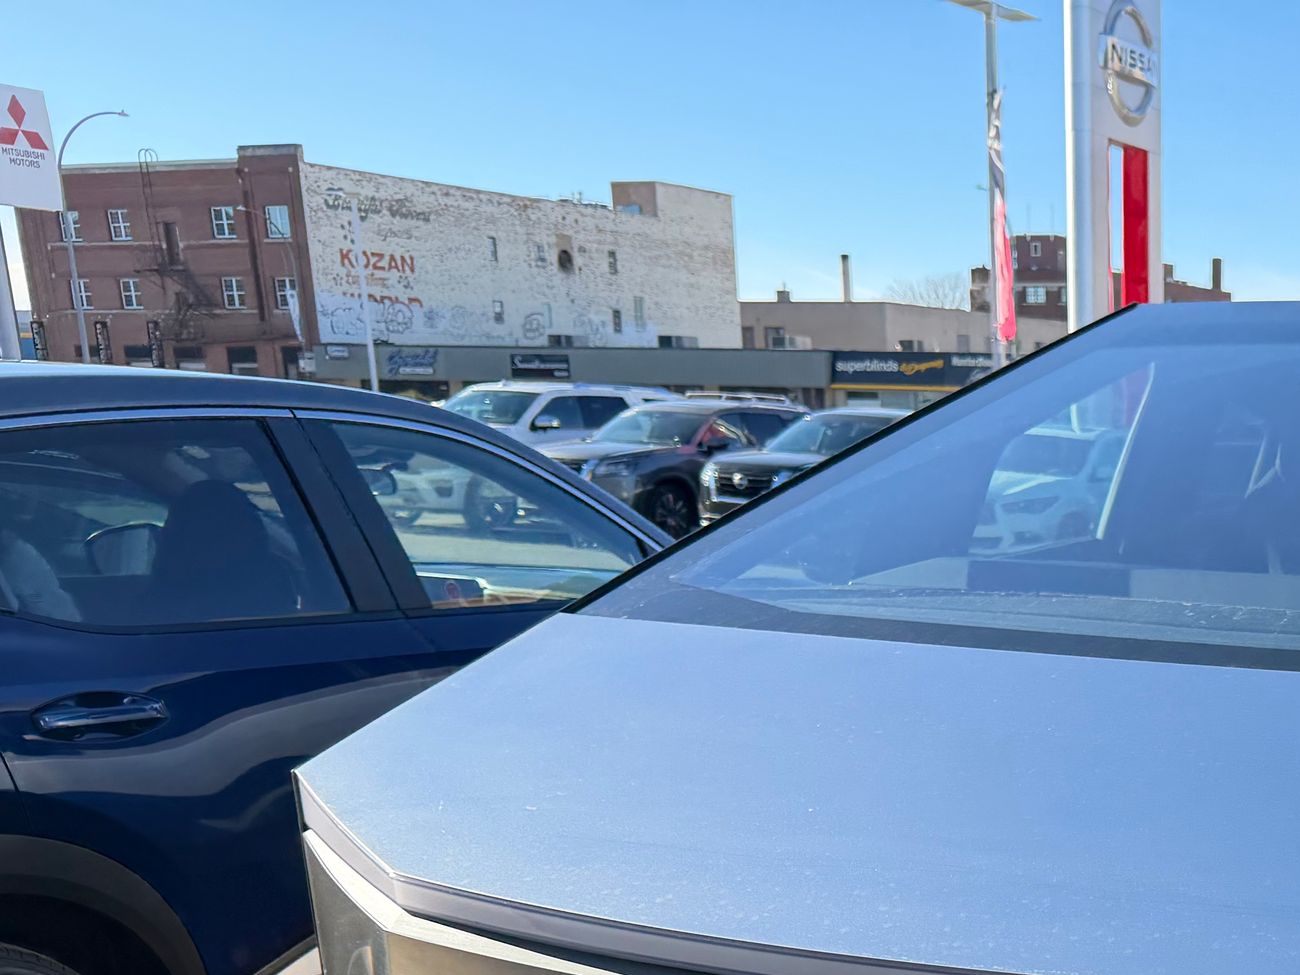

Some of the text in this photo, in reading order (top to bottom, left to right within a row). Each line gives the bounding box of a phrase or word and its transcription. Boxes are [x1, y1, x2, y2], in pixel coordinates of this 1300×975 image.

[2, 147, 46, 161] MITSUBISHI
[9, 157, 41, 169] MOTORS
[339, 248, 415, 274] KOZAN
[835, 358, 898, 374] superblinds
